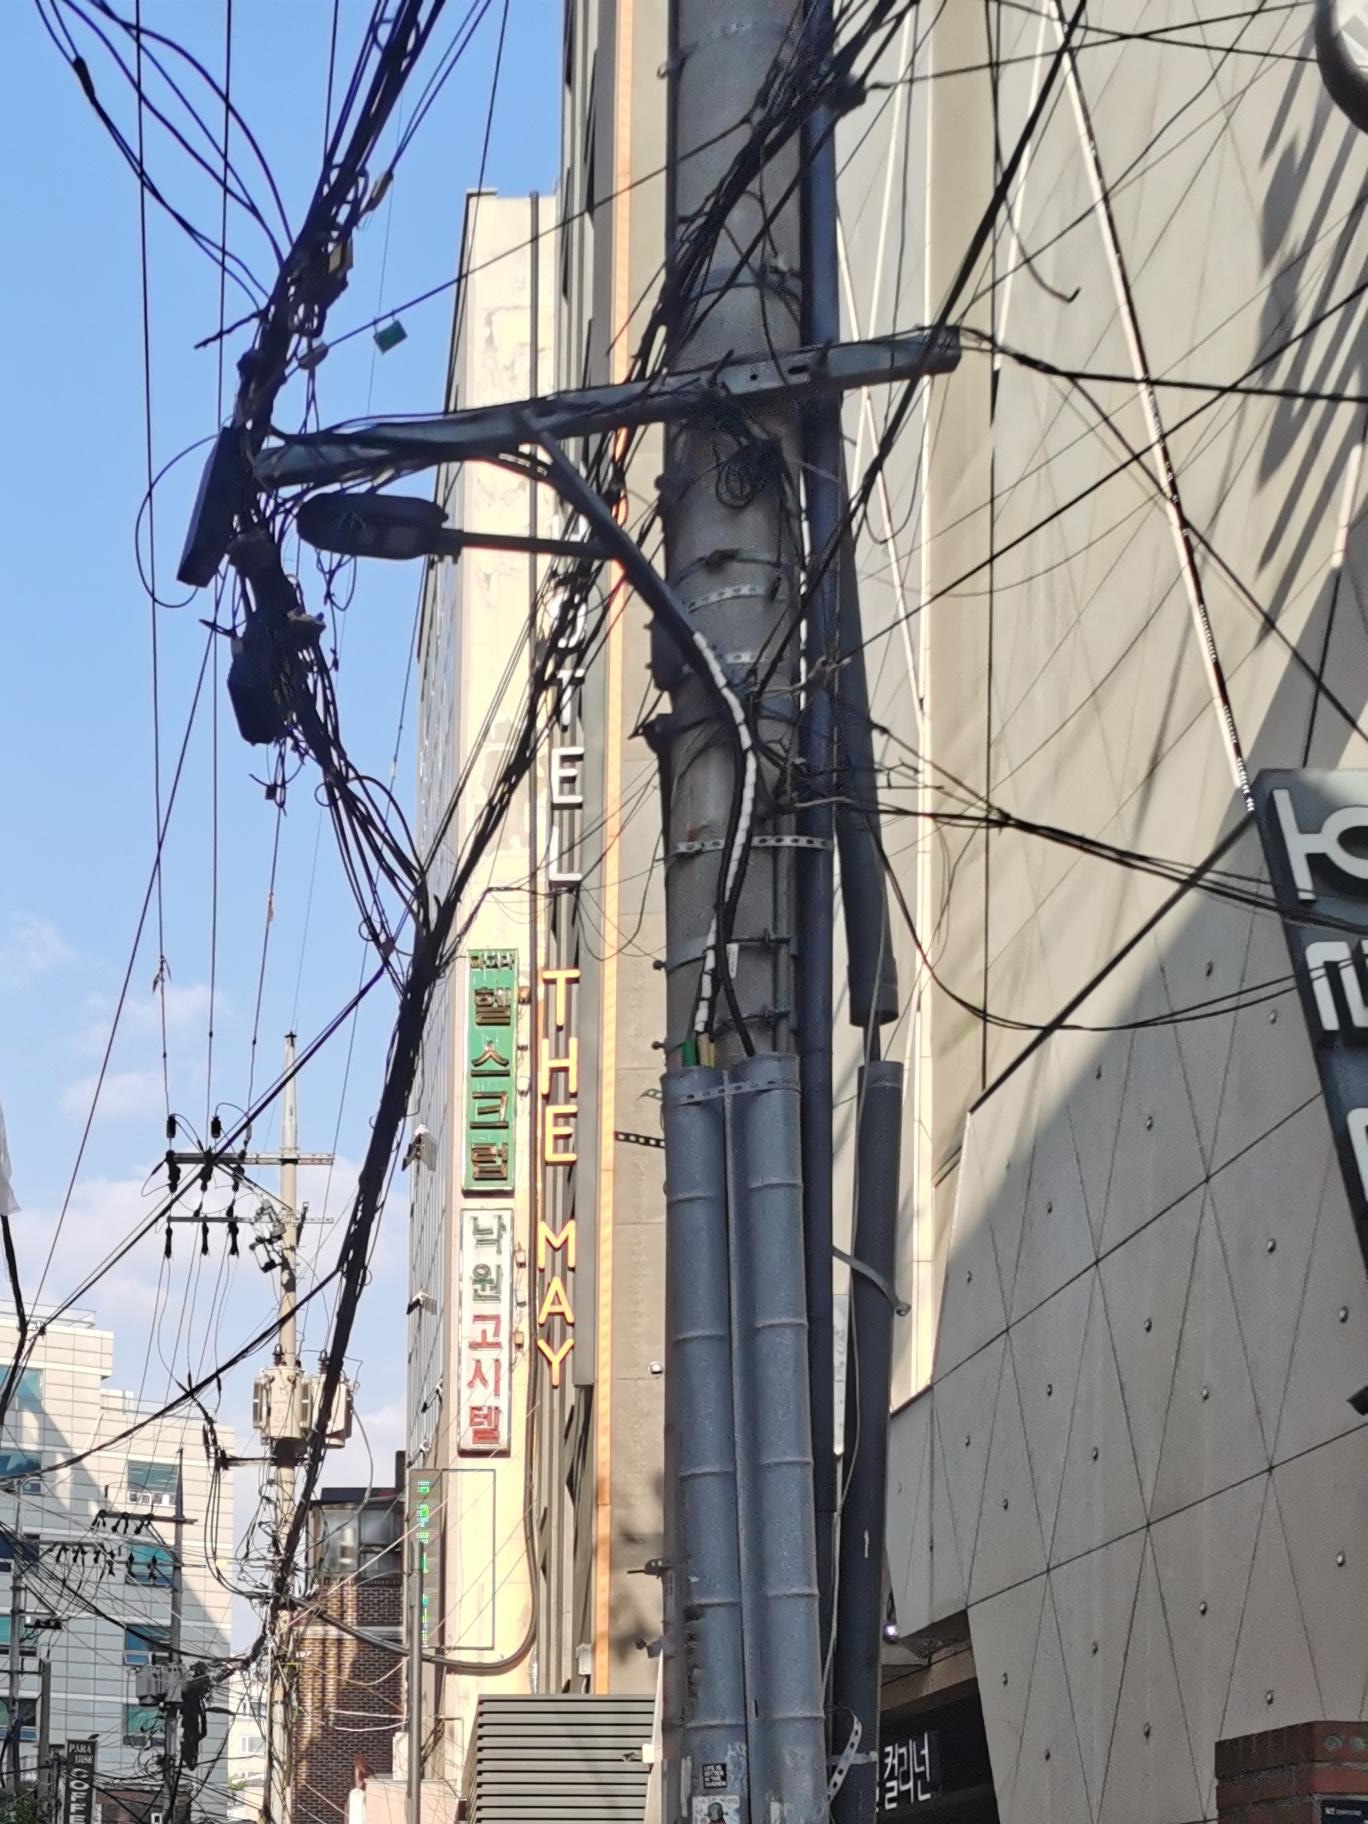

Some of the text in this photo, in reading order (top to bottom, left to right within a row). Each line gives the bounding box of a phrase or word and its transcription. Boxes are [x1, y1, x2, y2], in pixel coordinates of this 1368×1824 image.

[540, 969, 581, 1167] THE
[466, 1214, 508, 1445] 낙원고시텔
[536, 1218, 577, 1389] MAY
[884, 1732, 931, 1810] 컬리넌
